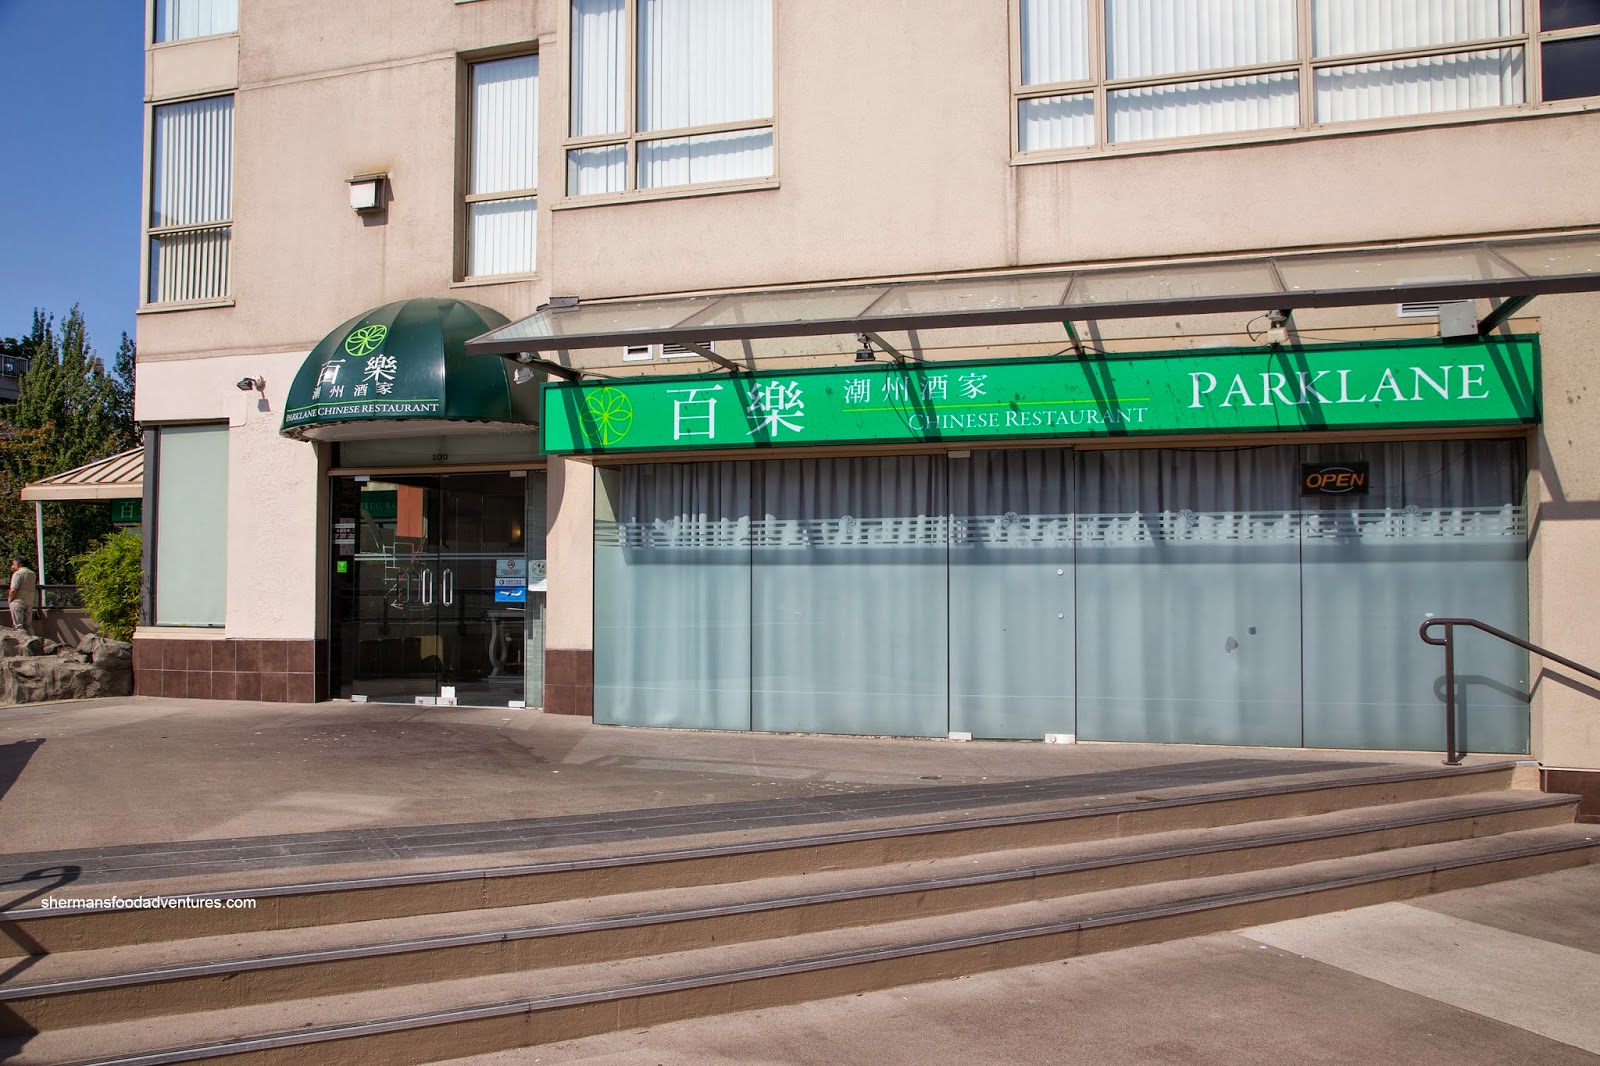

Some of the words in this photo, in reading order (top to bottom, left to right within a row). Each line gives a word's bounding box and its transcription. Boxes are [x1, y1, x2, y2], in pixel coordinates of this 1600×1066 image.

[317, 354, 398, 386] 百樂
[311, 382, 393, 400] 潮州酒家
[843, 372, 988, 404] 潮州酒家
[1187, 363, 1490, 409] PARKLANE
[286, 409, 317, 422] PARKLANE
[317, 404, 360, 416] CHINESE
[362, 403, 439, 413] RESTAURANT
[666, 380, 806, 441] 百樂
[909, 412, 999, 430] CHINESE
[1005, 407, 1148, 427] RESTAURANT
[432, 453, 448, 461] 200
[1306, 473, 1365, 489] OPEN
[120, 501, 135, 519] 百
